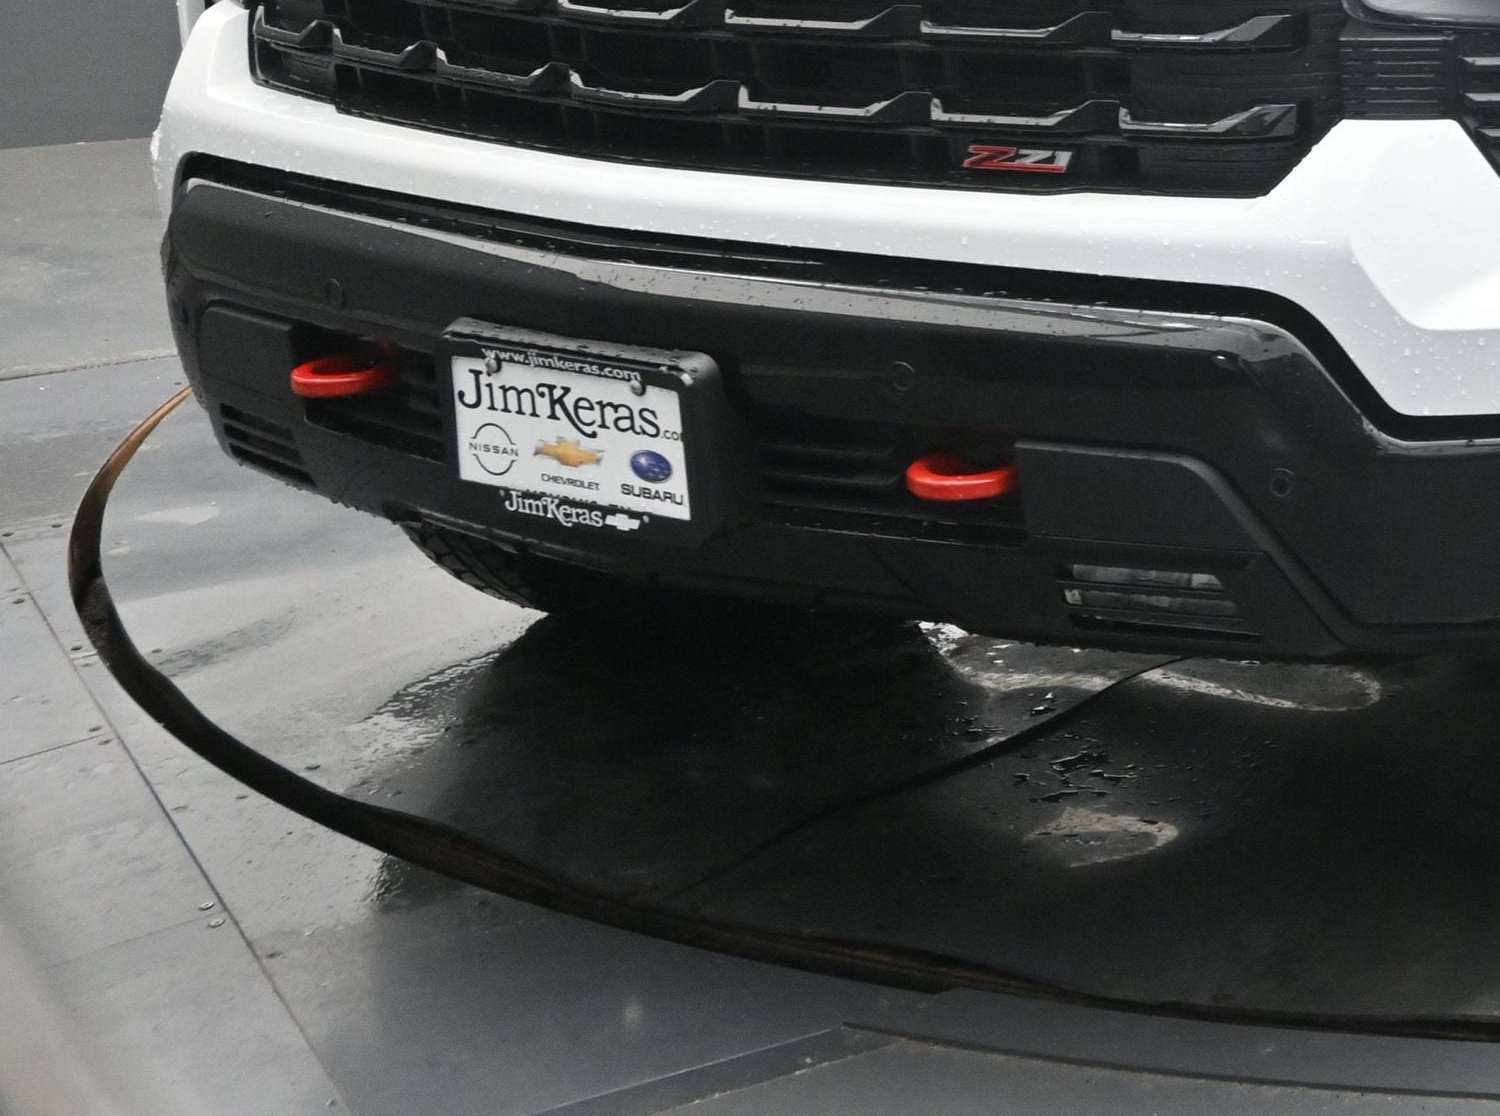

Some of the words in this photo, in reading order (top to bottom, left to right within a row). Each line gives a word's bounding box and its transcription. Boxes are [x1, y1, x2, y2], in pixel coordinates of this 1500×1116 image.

[962, 144, 1073, 174] Z71
[481, 347, 642, 382] www.jimkeras.com
[457, 369, 682, 441] JimKeras.co
[468, 441, 519, 458] NISSAN
[540, 472, 601, 492] CHEVROLET
[620, 483, 685, 506] SUBARU
[504, 490, 604, 527] JimKeras
